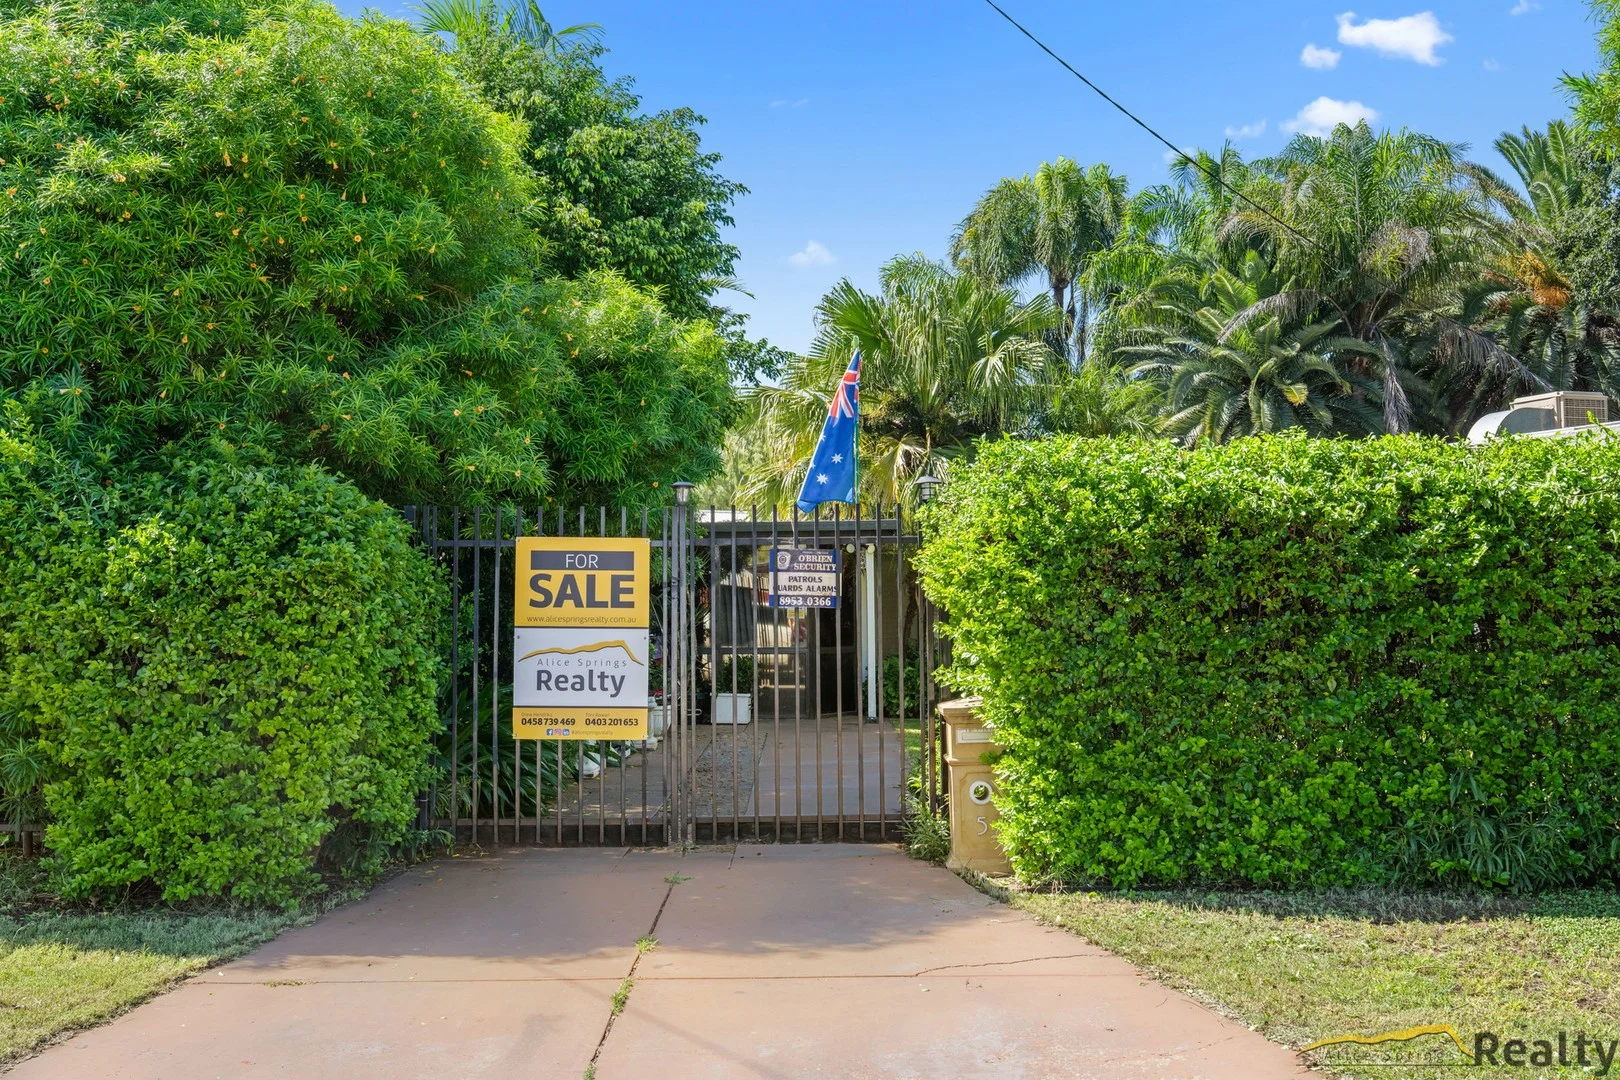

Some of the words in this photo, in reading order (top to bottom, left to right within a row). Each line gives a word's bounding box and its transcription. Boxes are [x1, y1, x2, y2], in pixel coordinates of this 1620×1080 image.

[565, 553, 599, 569] FOR
[798, 554, 833, 563] O'BRIEN
[793, 563, 837, 571] SECURITY
[529, 573, 635, 609] SALE
[807, 597, 831, 606] 0366
[527, 615, 637, 624] www.alicespringsrealty.com.au
[536, 658, 570, 667] Alice
[577, 659, 627, 669] Springs
[536, 669, 626, 698] Realty
[521, 718, 543, 726] 0458
[544, 718, 559, 726] 739
[560, 718, 576, 726] 469
[585, 718, 607, 726] 0403
[976, 816, 988, 835] 5
